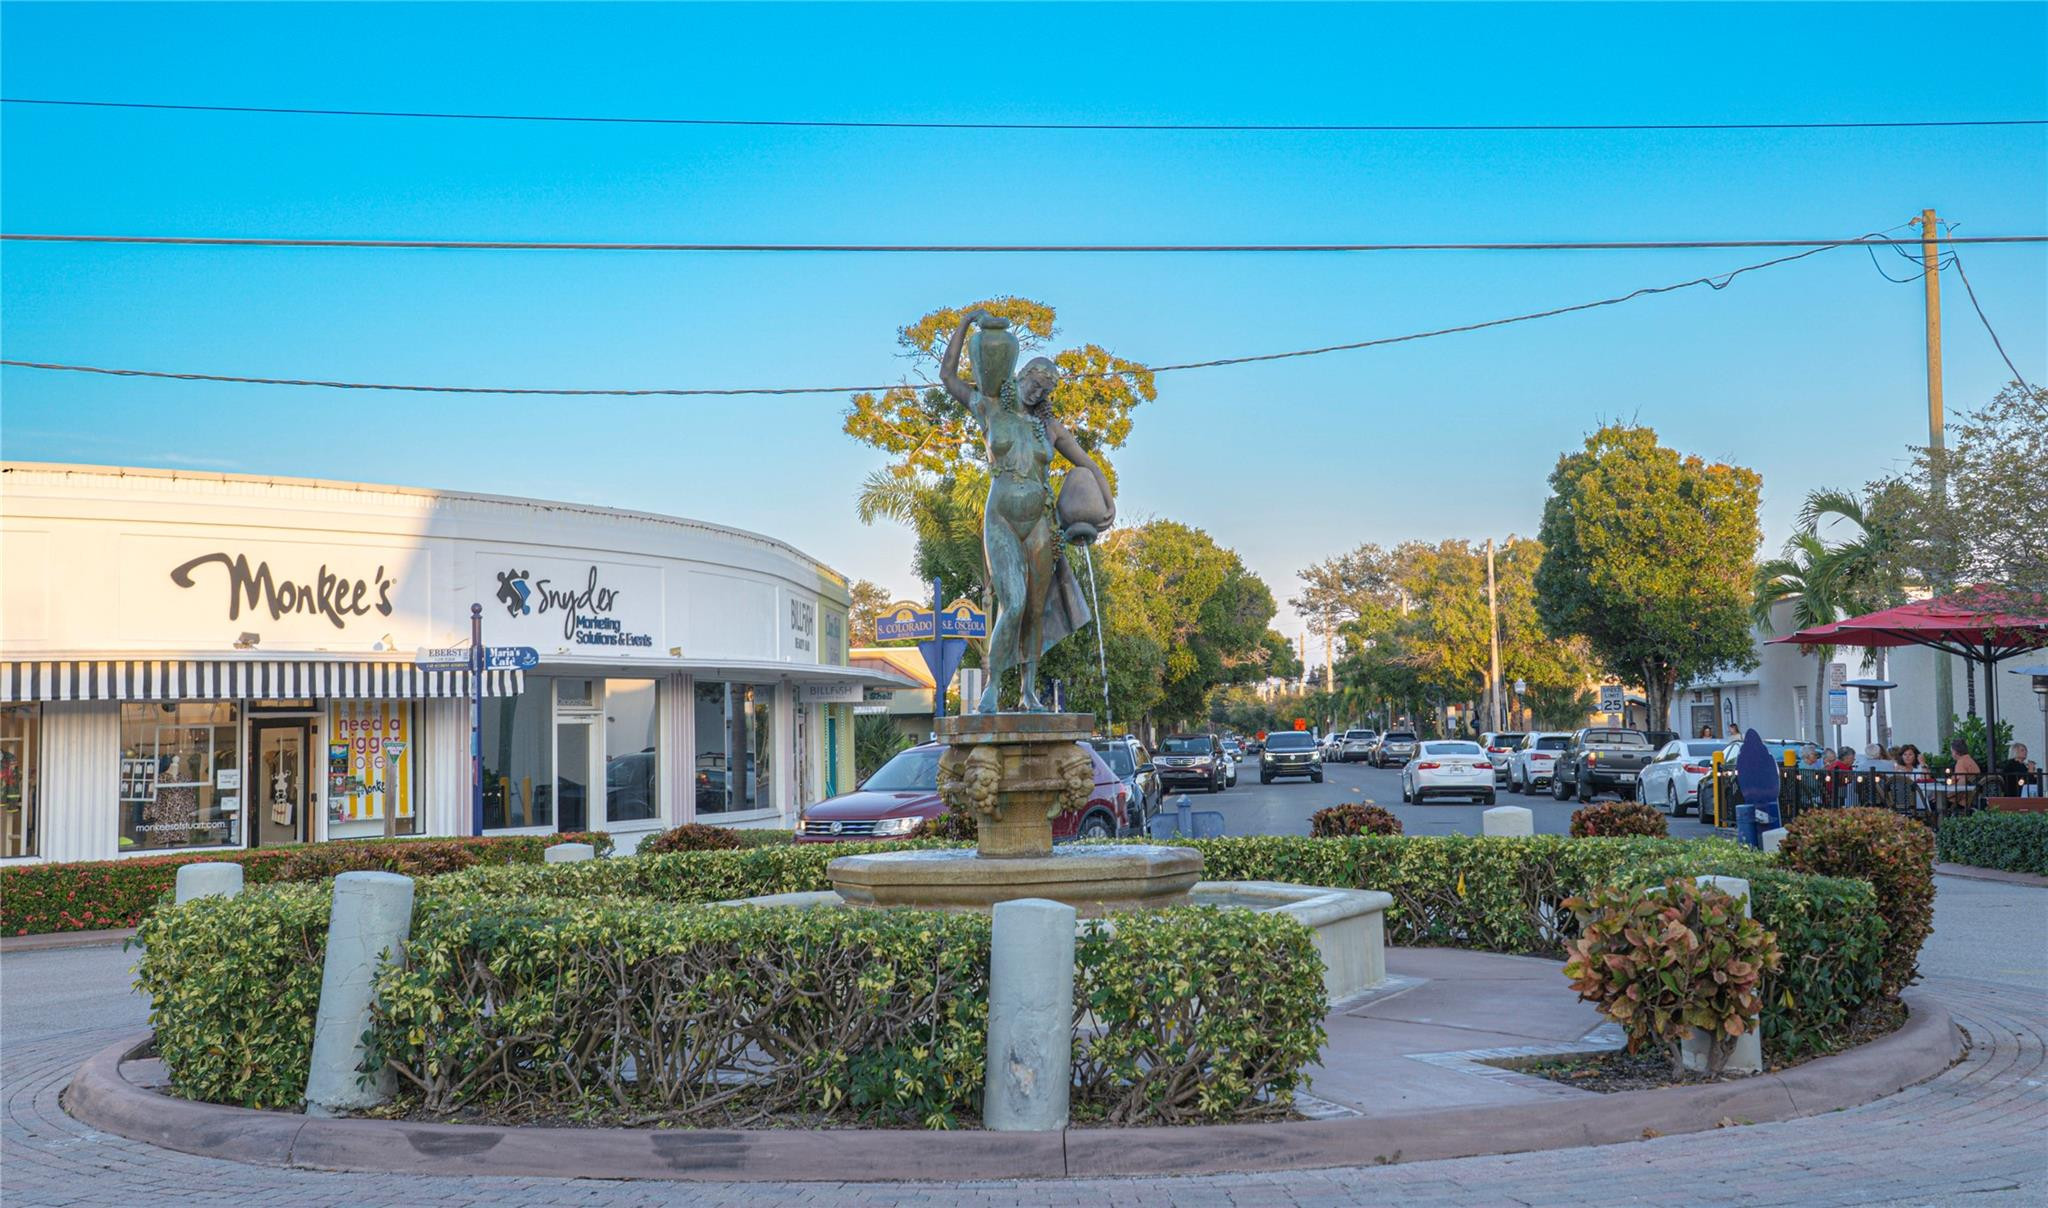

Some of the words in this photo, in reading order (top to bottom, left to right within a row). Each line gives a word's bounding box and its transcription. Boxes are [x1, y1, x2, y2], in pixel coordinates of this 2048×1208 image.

[170, 552, 393, 629] Monkee's
[536, 565, 620, 640] Snyder
[576, 615, 621, 633] Marketing
[886, 621, 932, 634] COLORADO
[942, 620, 954, 630] S.E.
[954, 621, 985, 631] OSCEOLA
[576, 630, 617, 645] Solutions
[617, 632, 625, 646] &
[626, 632, 652, 647] Events
[428, 648, 463, 657] EBERST
[489, 647, 520, 658] Maria's
[1604, 700, 1622, 711] 25
[339, 714, 383, 731] need
[389, 719, 401, 731] a
[135, 821, 226, 832] monkeesofstuart.com
